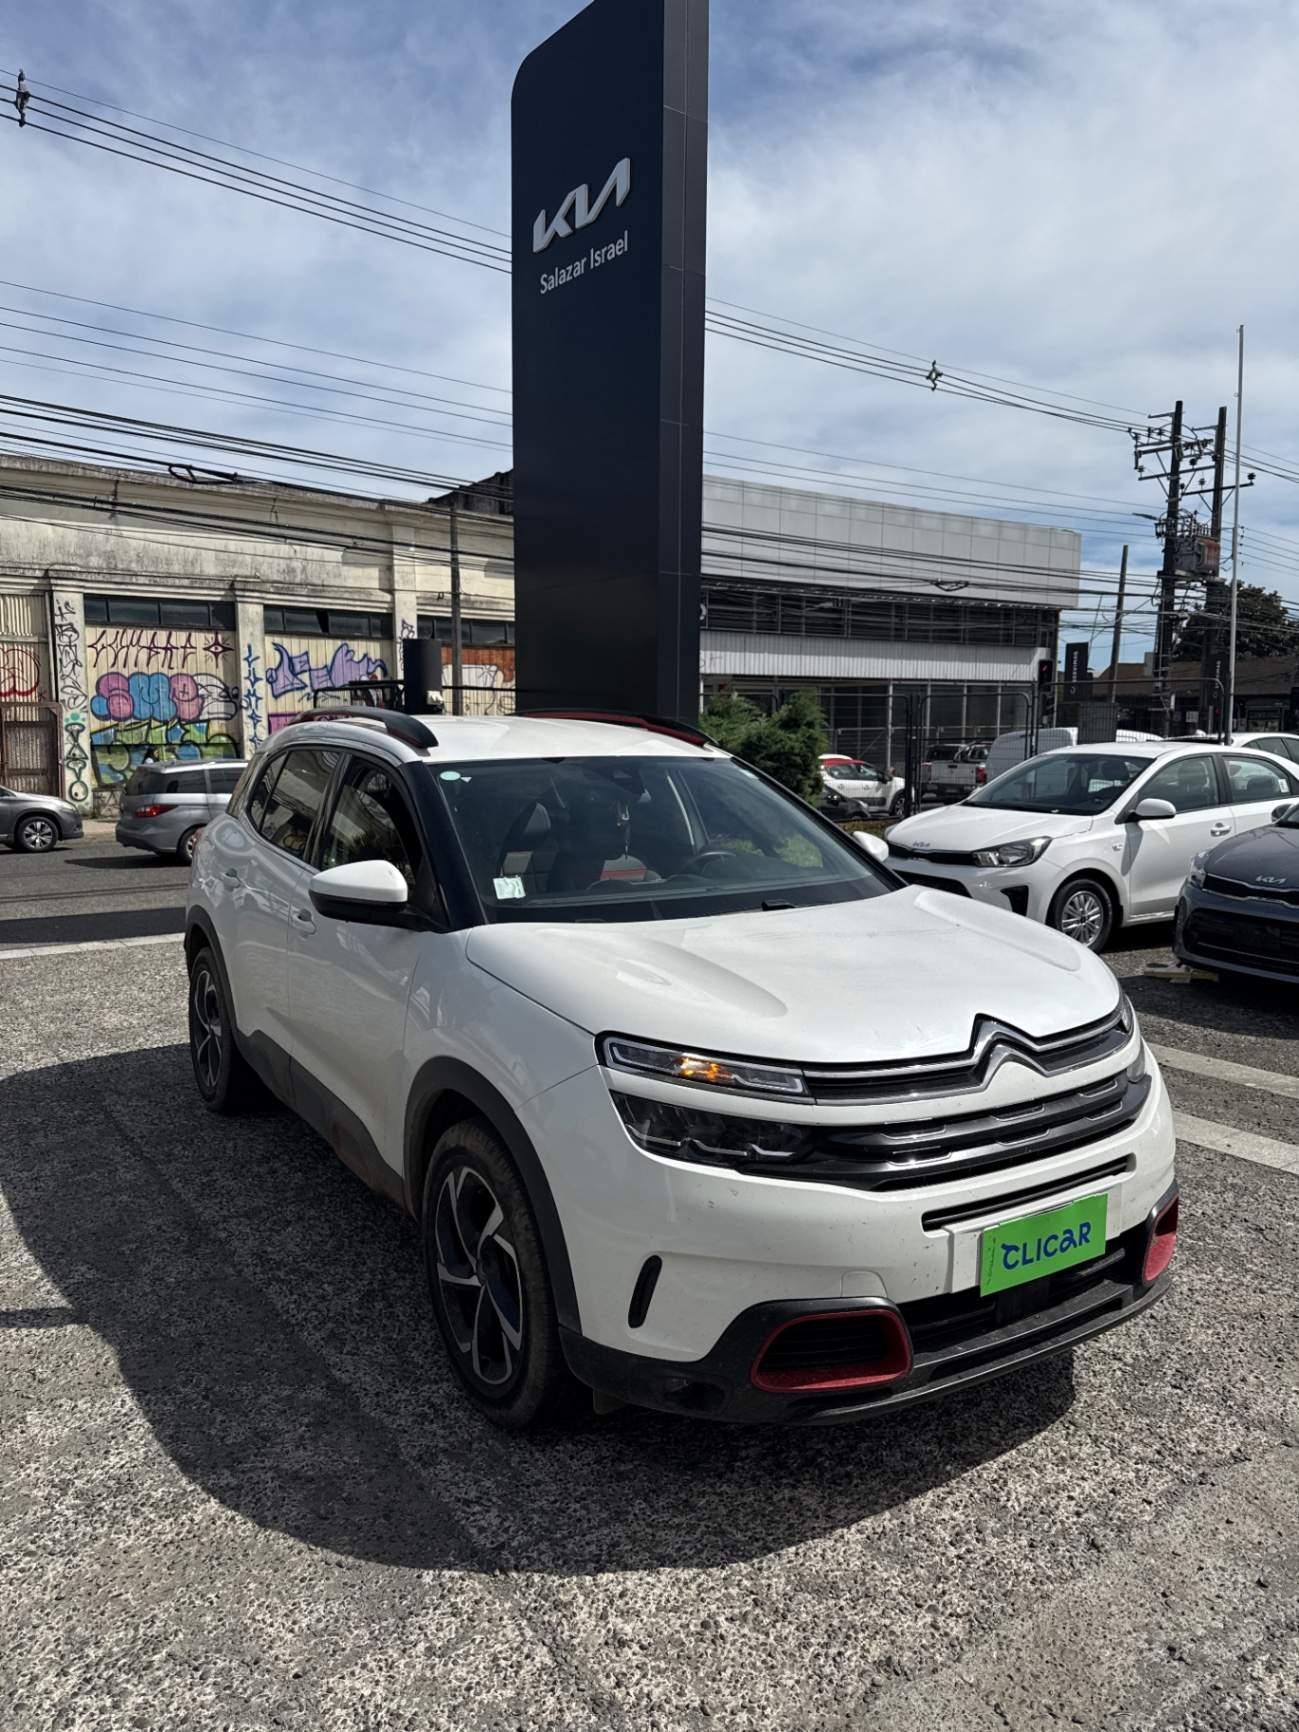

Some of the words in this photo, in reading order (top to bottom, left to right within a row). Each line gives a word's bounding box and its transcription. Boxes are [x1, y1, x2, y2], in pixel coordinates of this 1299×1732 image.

[532, 157, 631, 254] KIA
[539, 257, 587, 295] Salazar
[590, 230, 629, 270] Israel
